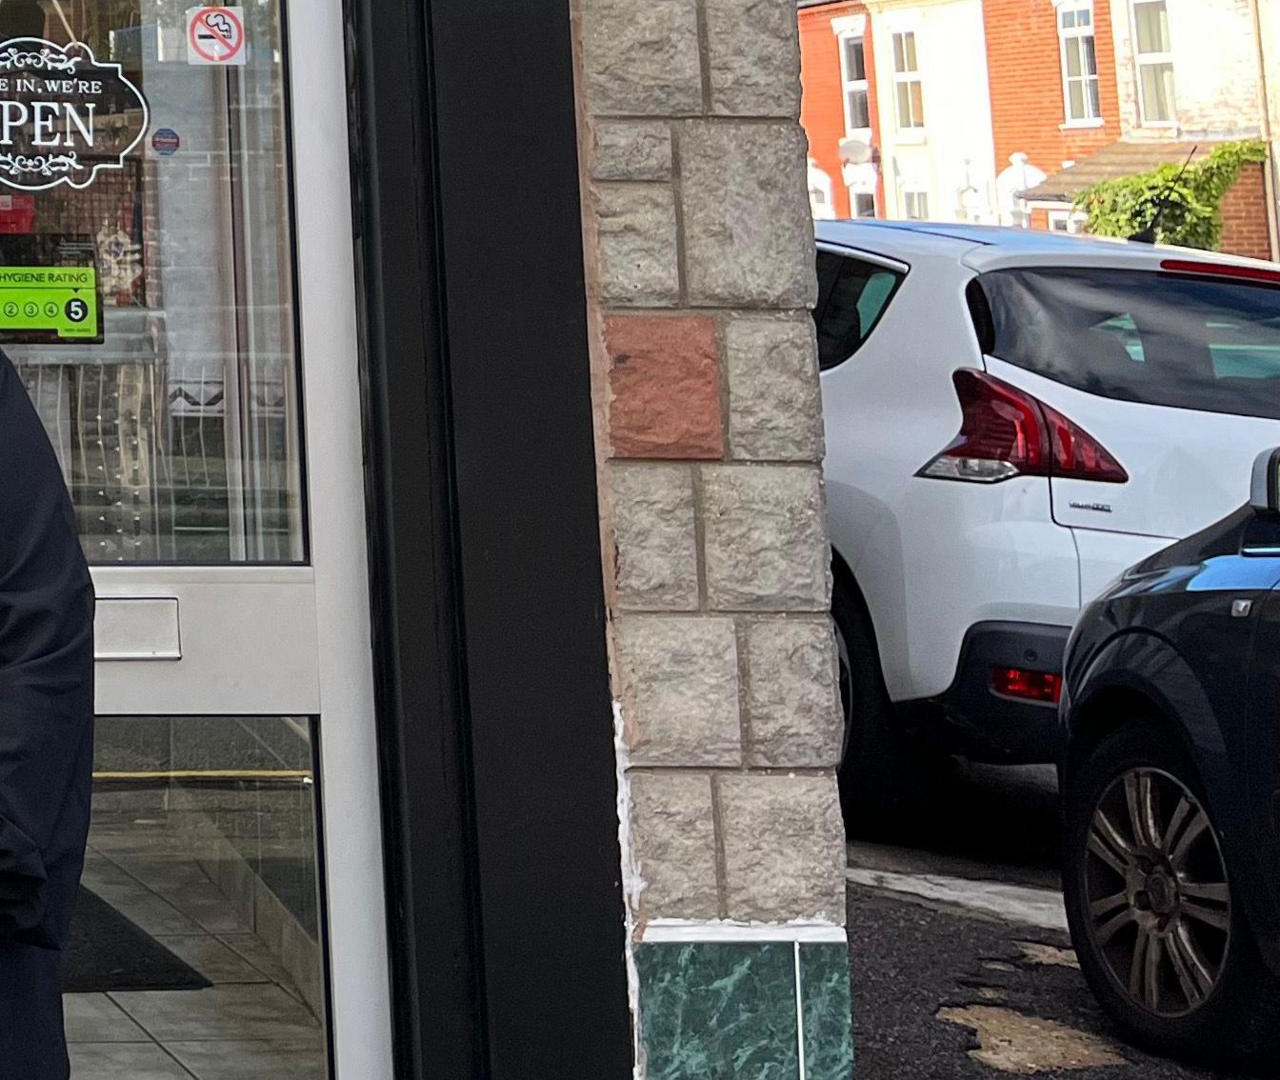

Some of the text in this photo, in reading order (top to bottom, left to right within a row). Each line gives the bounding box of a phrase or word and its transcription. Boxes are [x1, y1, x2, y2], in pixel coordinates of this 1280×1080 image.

[44, 77, 102, 94] WE'RE
[47, 272, 88, 283] RATING
[70, 301, 83, 320] 5
